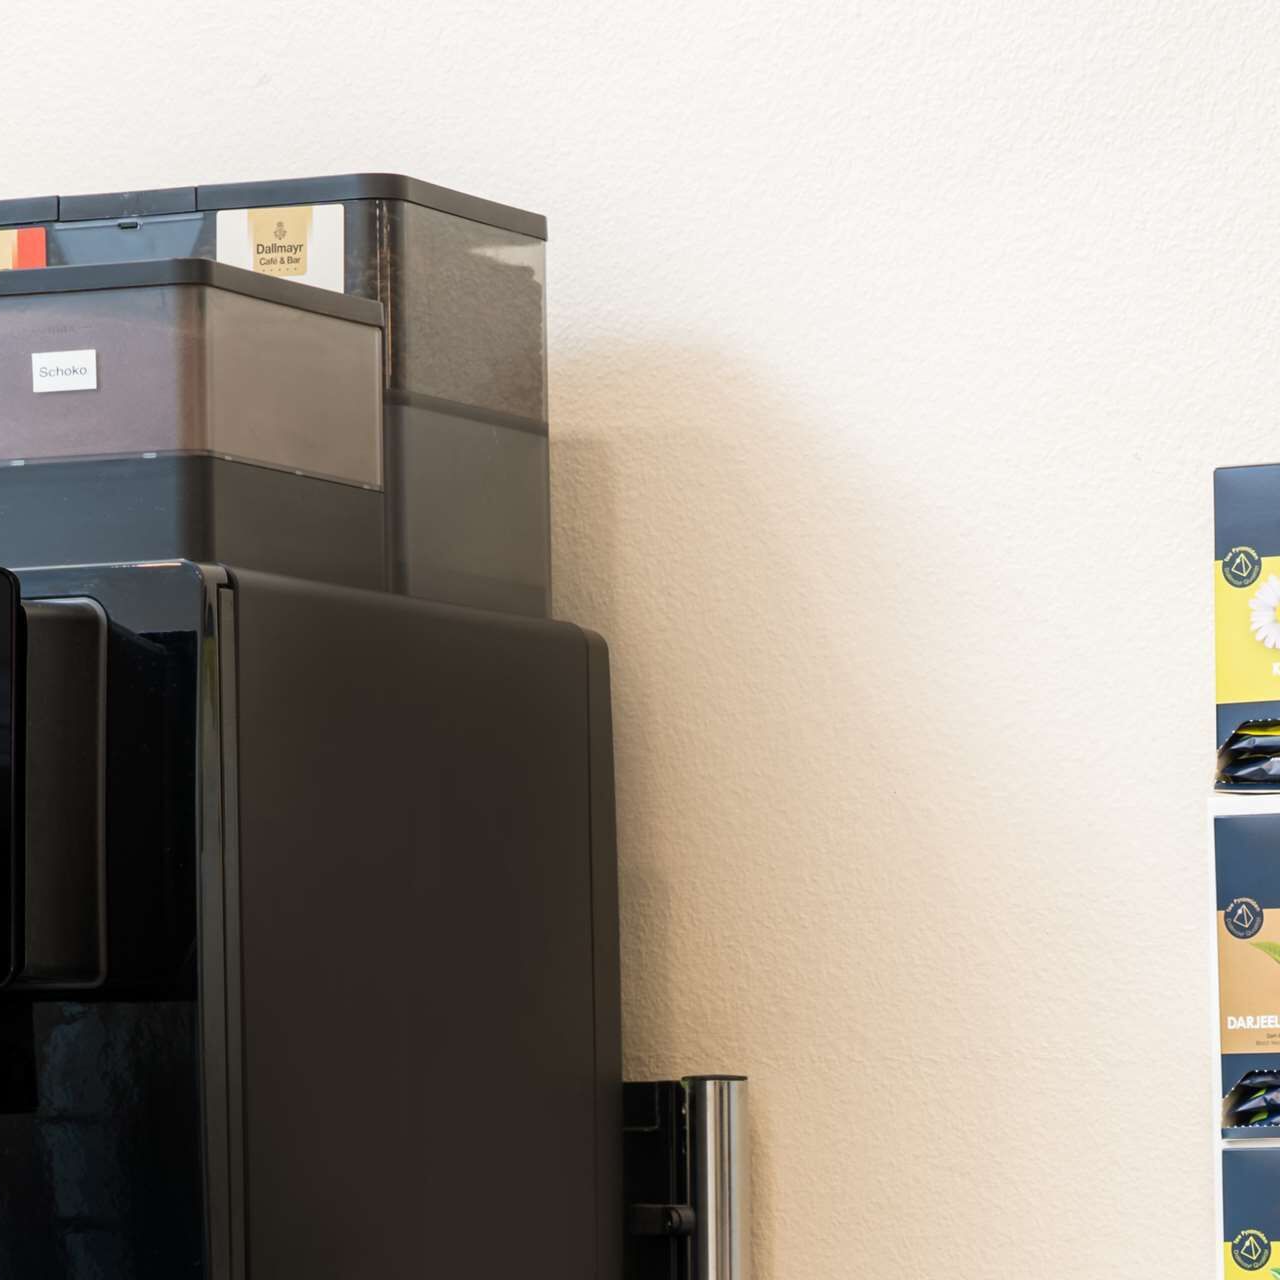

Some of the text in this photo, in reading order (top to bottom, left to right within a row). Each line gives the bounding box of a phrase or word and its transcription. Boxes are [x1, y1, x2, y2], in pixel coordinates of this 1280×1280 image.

[256, 241, 304, 257] Dallmayr
[259, 256, 301, 266] Café & Bar
[39, 365, 87, 379] Schoko
